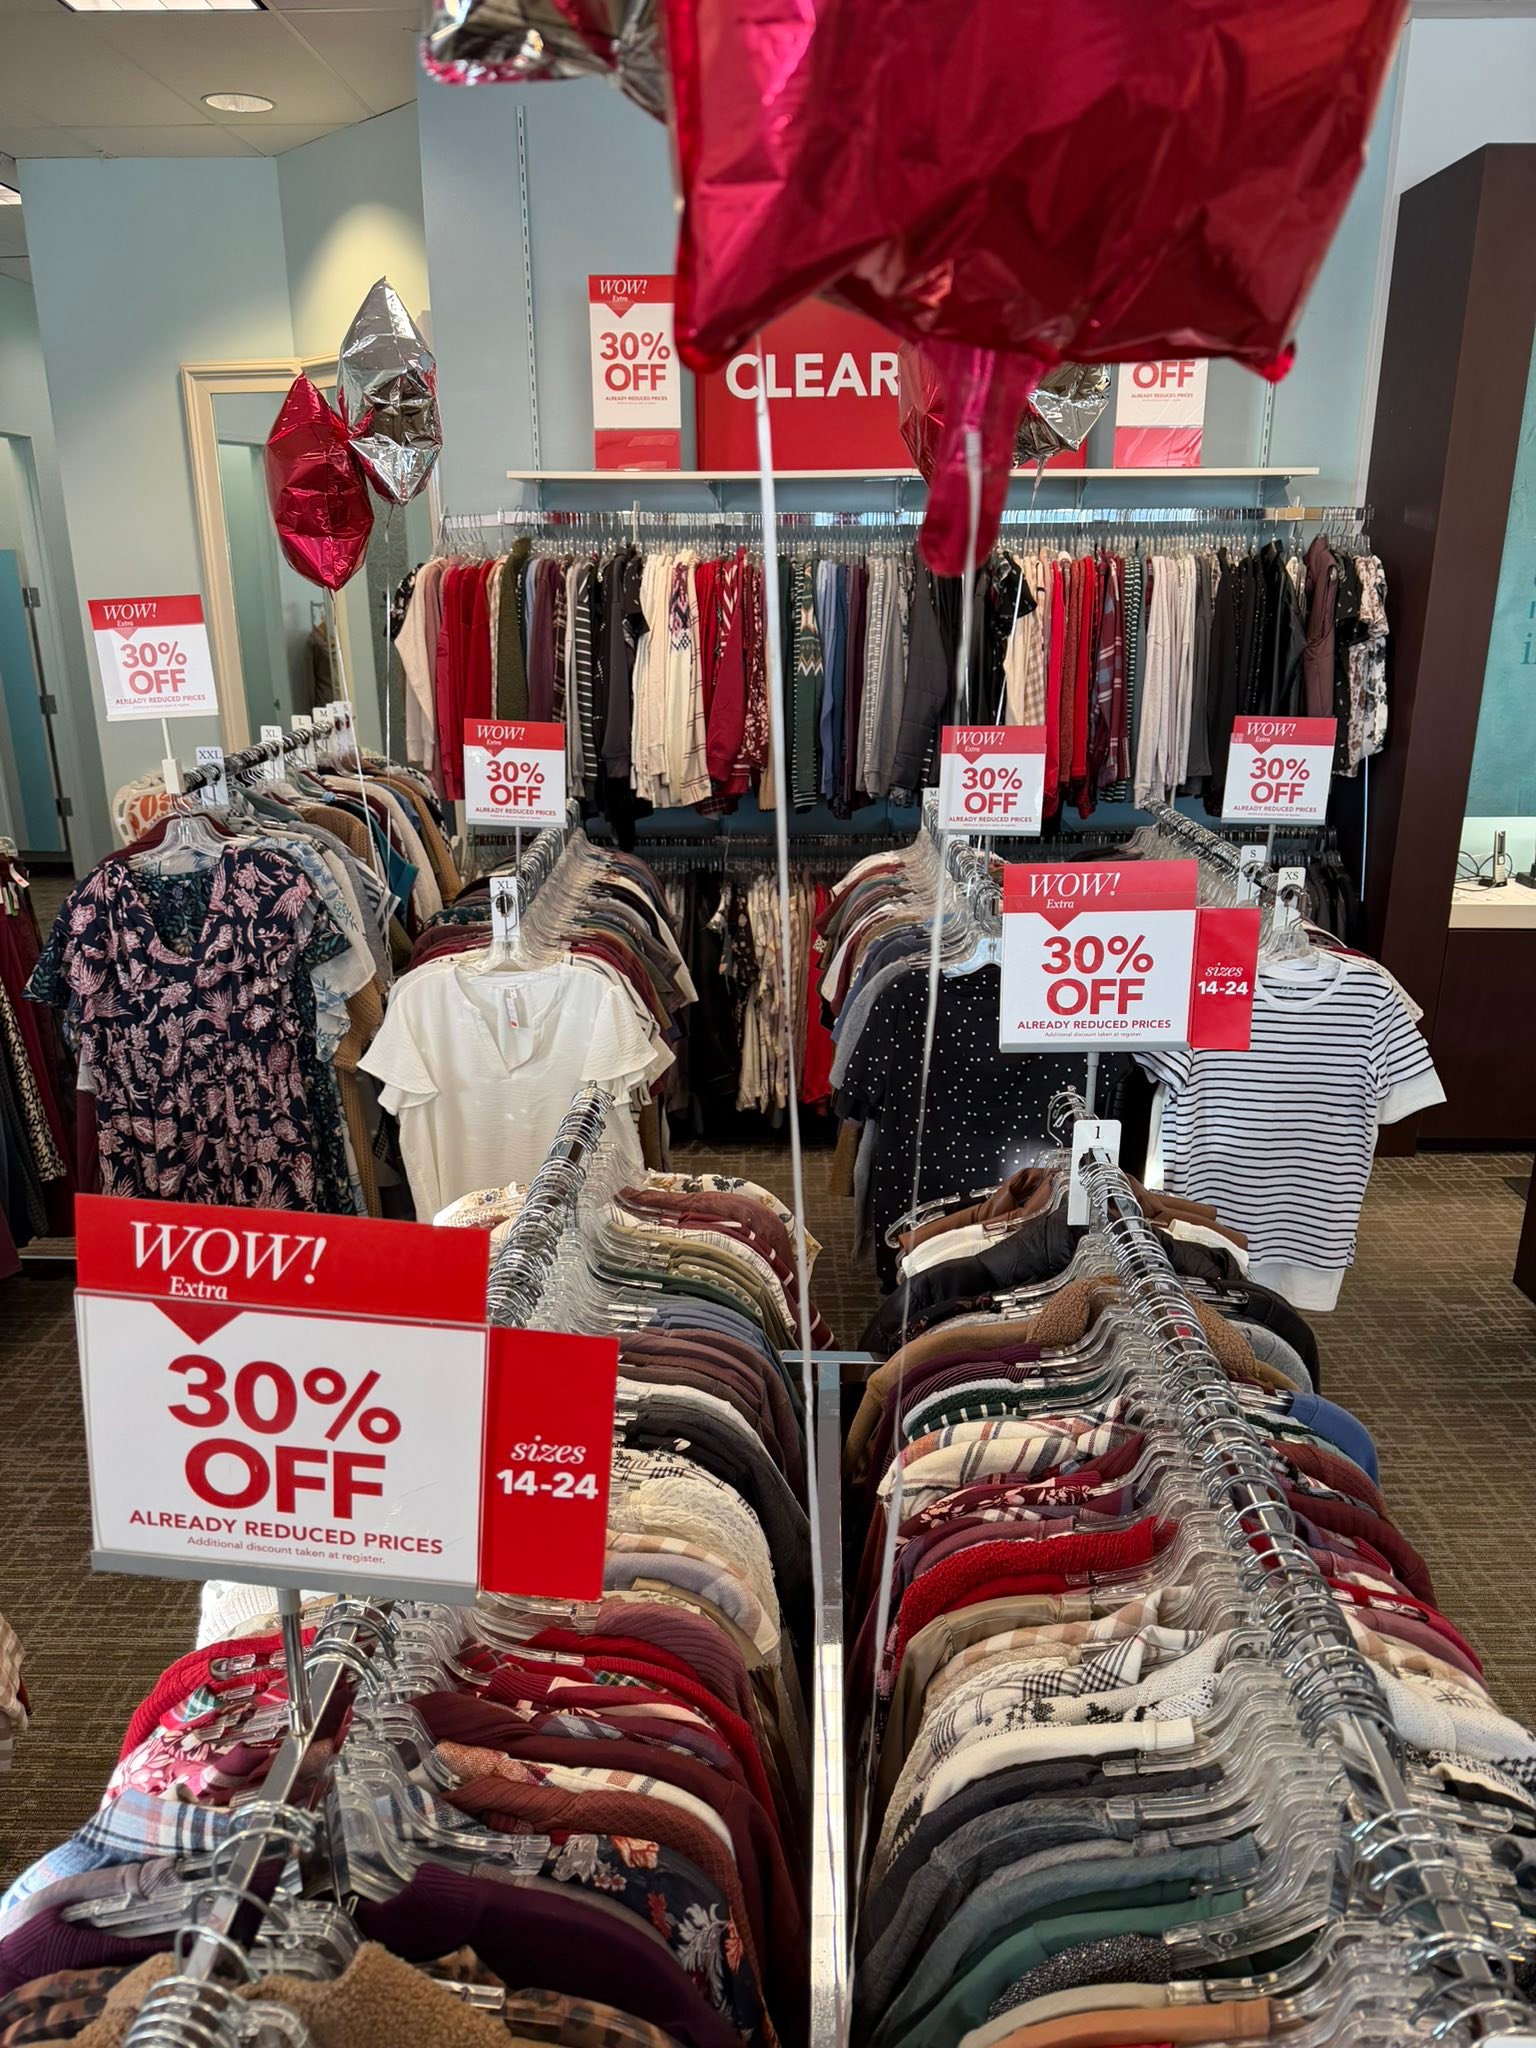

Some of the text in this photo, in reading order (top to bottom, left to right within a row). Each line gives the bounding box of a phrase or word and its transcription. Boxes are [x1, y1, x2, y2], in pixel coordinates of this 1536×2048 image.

[600, 280, 648, 294] WOW!
[600, 332, 670, 360] 30%
[605, 363, 666, 391] OFF
[1133, 361, 1195, 388] OFF
[103, 603, 156, 620] WOW!
[120, 641, 187, 668] 30%
[129, 668, 186, 694] OFF
[266, 730, 278, 738] XL
[477, 725, 525, 740] WOW!
[956, 732, 1005, 746] WOW!
[1247, 722, 1296, 736] WOW!
[199, 751, 222, 759] XXL
[486, 760, 544, 784] 30%
[962, 768, 1022, 790] 30%
[1250, 758, 1310, 780] 30%
[490, 784, 541, 806] OFF
[964, 792, 1018, 814] OFF
[1251, 782, 1304, 804] OFF
[1250, 850, 1256, 858] S
[497, 880, 512, 890] XL
[1029, 872, 1120, 898] WOW!
[1285, 872, 1298, 880] XS
[1046, 899, 1074, 909] Extra
[1041, 934, 1154, 974] 30%
[1205, 962, 1243, 977] sizes
[1046, 978, 1145, 1016] OFF
[1198, 981, 1248, 996] 14-24
[1018, 1020, 1171, 1030] ALREADY REDUCED PRICES
[131, 1221, 327, 1284] WOW!
[169, 1276, 228, 1300] Extra
[168, 1354, 402, 1444] 30%
[511, 1435, 586, 1464] sizes
[184, 1438, 386, 1520] OFF
[496, 1469, 599, 1500] 14-24
[129, 1509, 443, 1555] ALREADY REDUCED PRICES
[187, 1536, 386, 1566] Additional discount taken at register.
